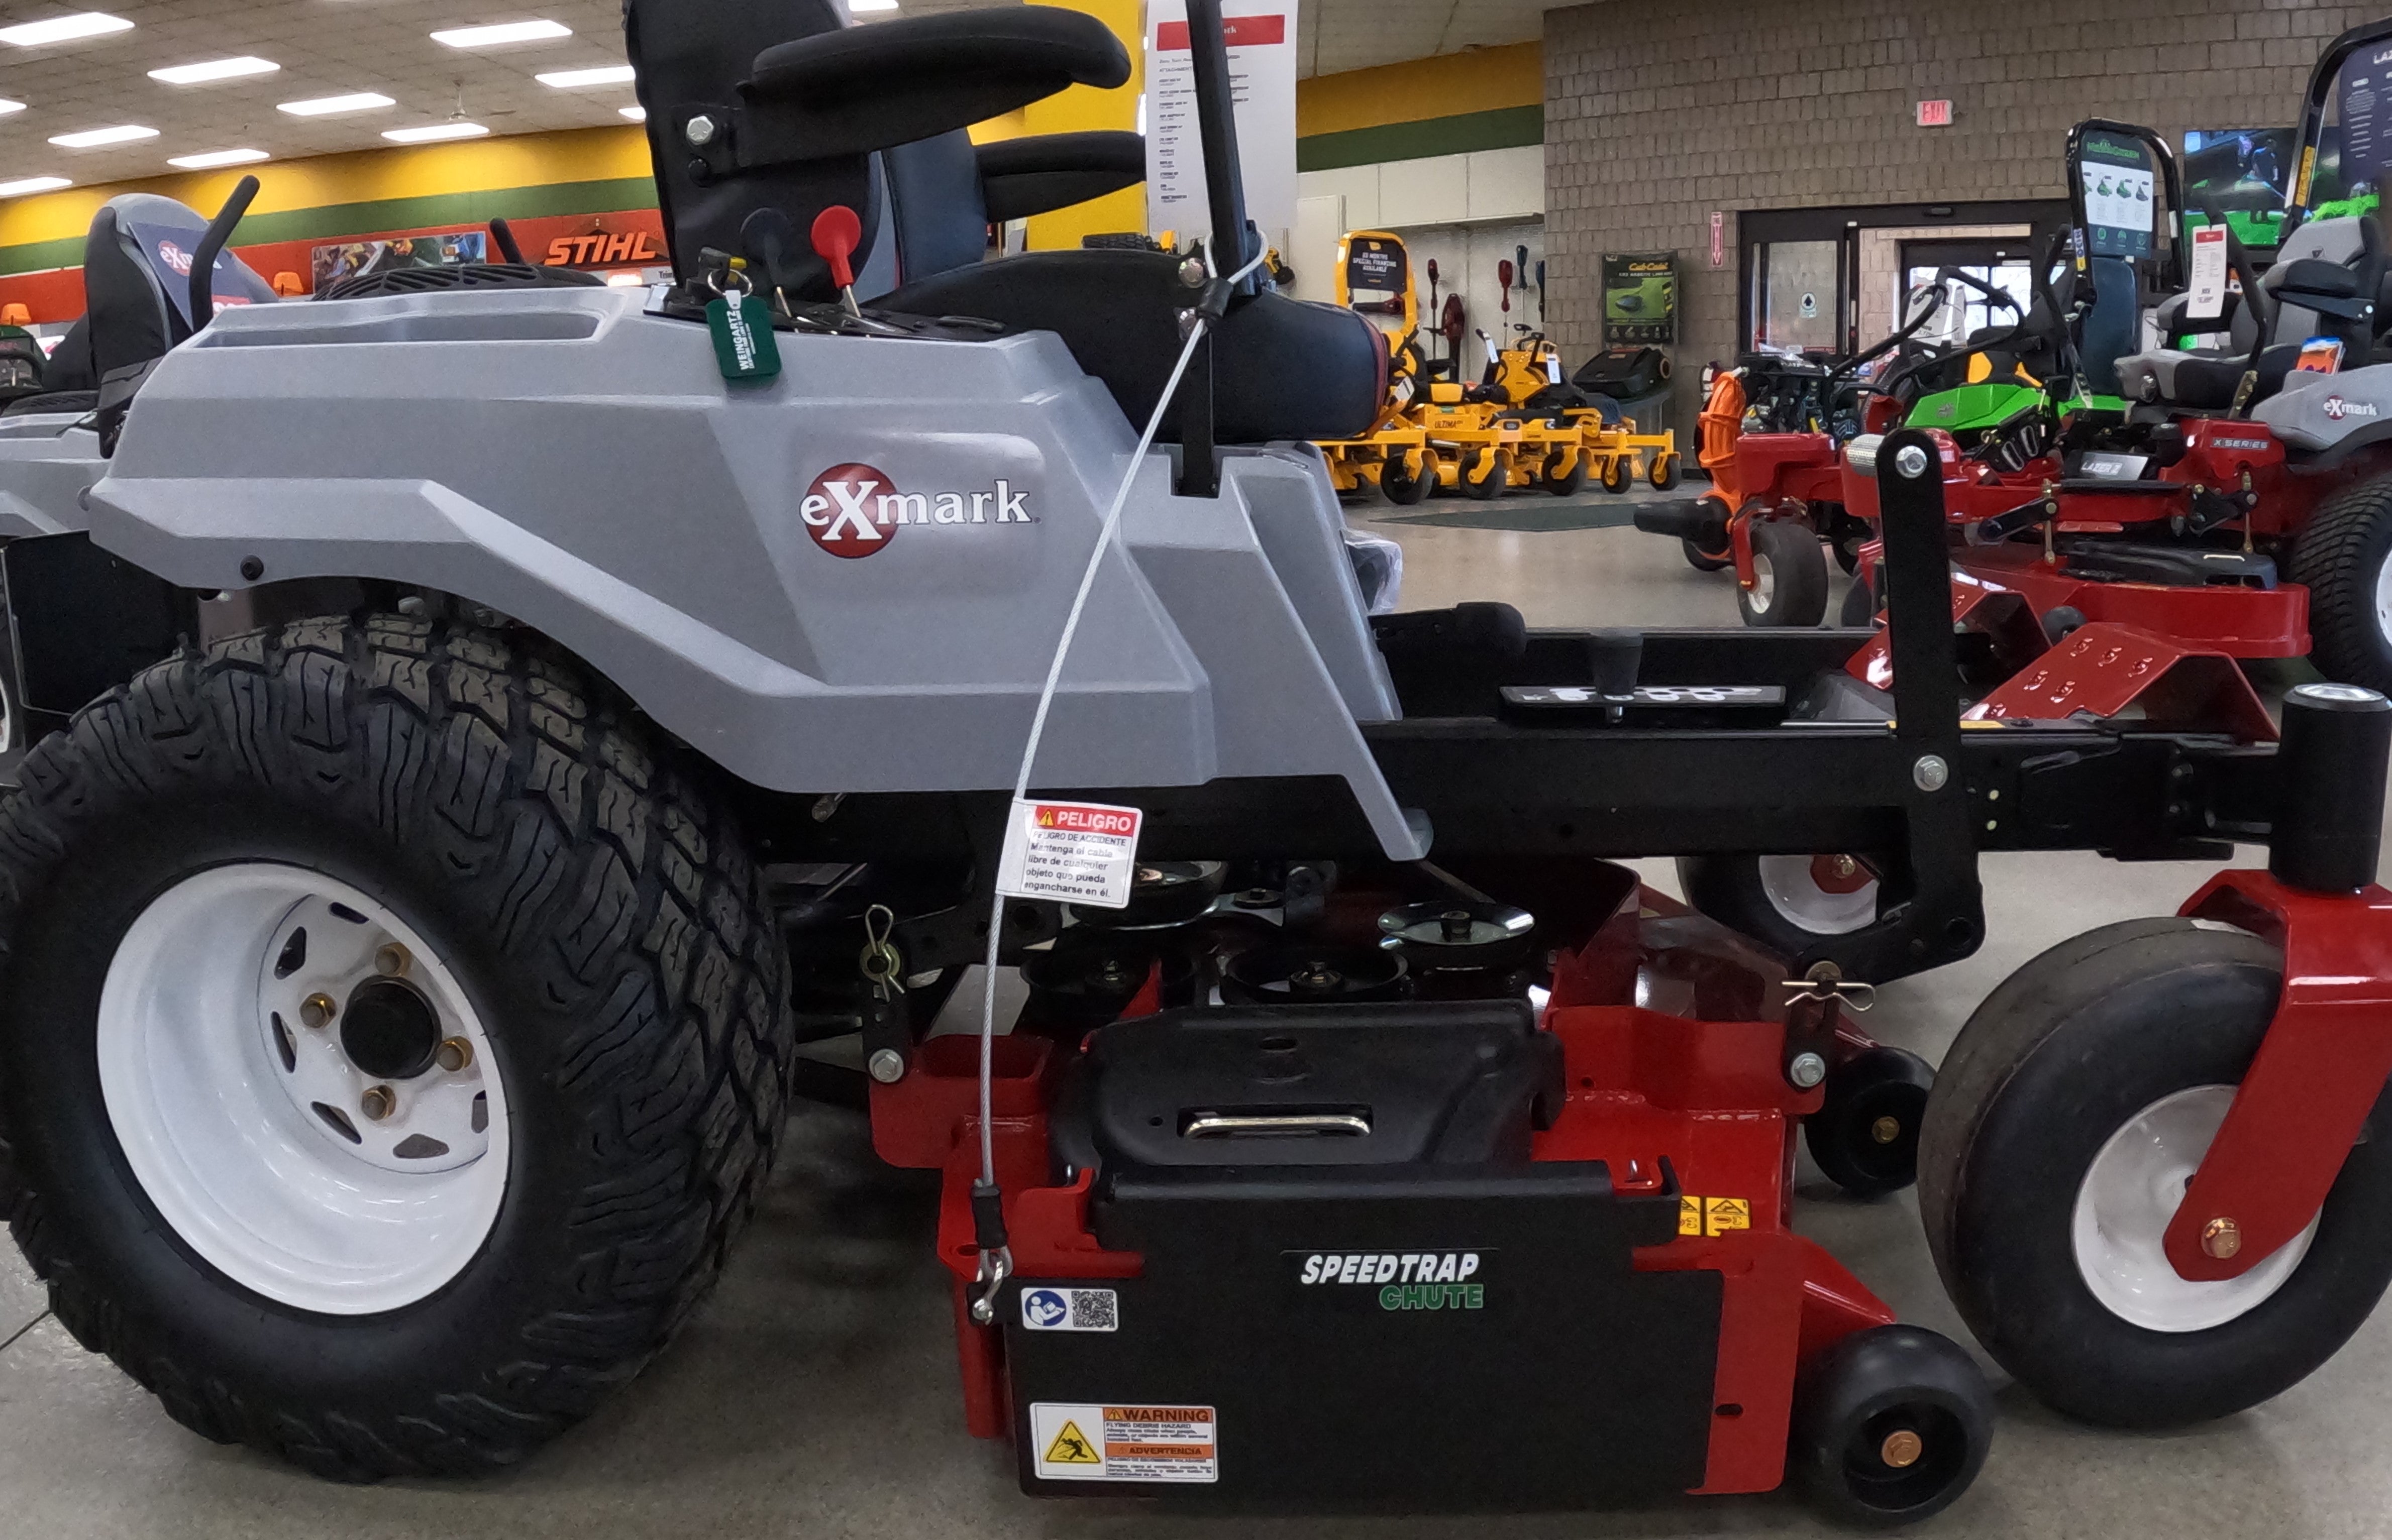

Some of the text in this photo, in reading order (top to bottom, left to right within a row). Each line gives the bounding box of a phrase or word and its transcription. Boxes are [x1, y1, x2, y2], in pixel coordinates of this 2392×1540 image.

[544, 231, 656, 266] STIHL
[726, 310, 750, 370] WEINGARTZ
[2323, 399, 2377, 417] eXmark
[799, 478, 1034, 541] eXmark
[1057, 811, 1131, 831] PELIGRO
[1080, 835, 1126, 846] ACCIDENTE
[1031, 842, 1074, 854] Mantenga
[1088, 848, 1113, 857] cable
[1028, 855, 1108, 870] libre de cualquier
[1026, 867, 1105, 883] objeto que pueda
[1024, 882, 1082, 894] engancharse
[1300, 1254, 1480, 1285] SPEEDTRAP
[1379, 1283, 1484, 1310] CHUTE
[1122, 1409, 1209, 1422] WARNING
[1129, 1447, 1202, 1455] ADVERTENCIA
